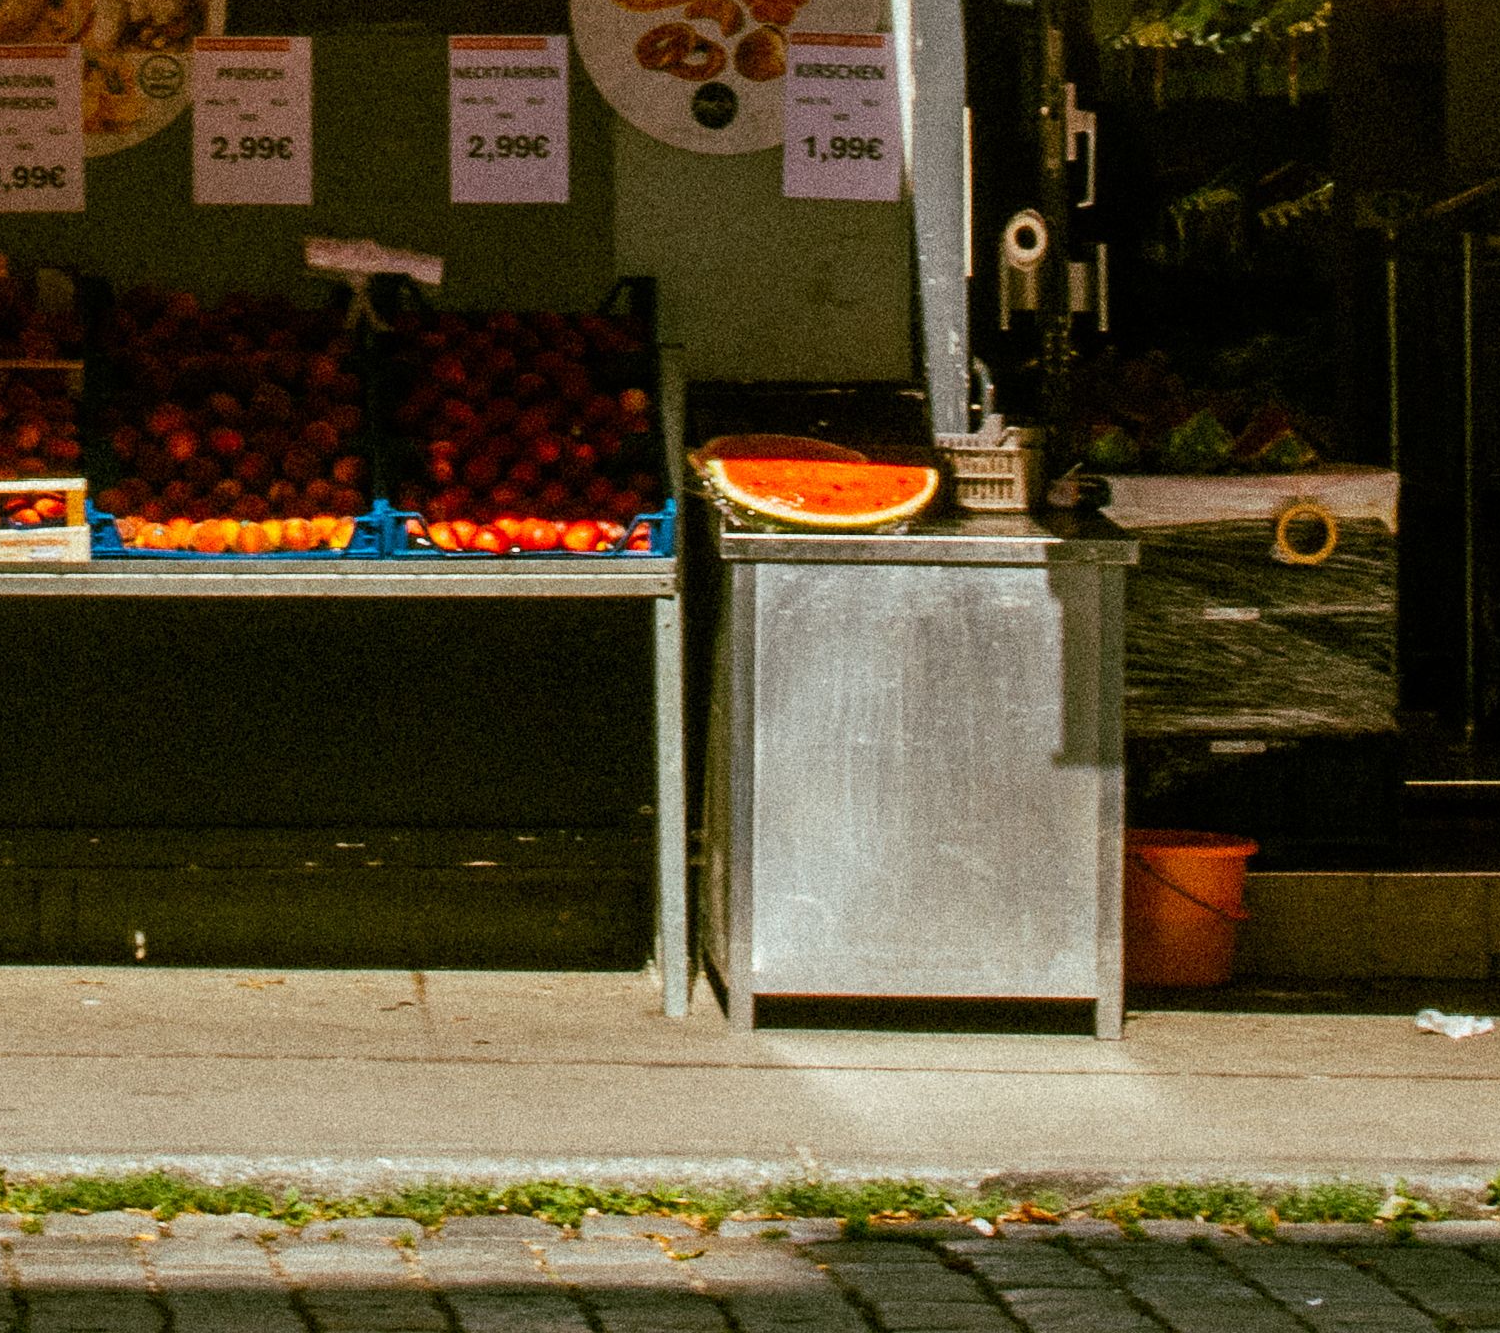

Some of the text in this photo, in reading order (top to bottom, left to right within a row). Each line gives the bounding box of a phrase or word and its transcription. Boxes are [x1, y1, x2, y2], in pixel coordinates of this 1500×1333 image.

[794, 63, 887, 81] KIRSCHEN
[210, 135, 294, 163] 2,99€
[467, 134, 551, 163] 2,99€
[802, 135, 885, 163] 1,99€
